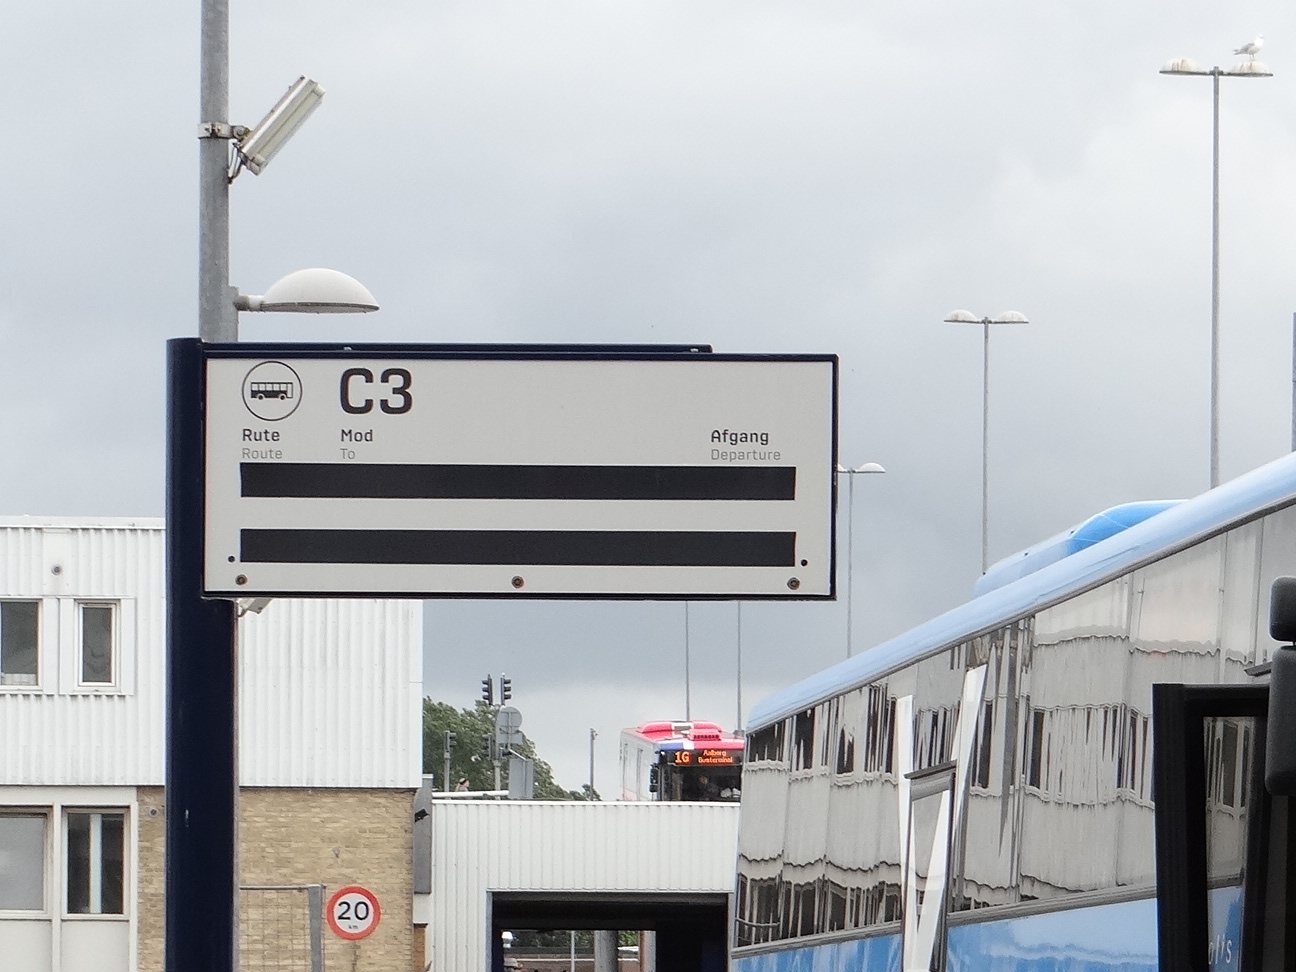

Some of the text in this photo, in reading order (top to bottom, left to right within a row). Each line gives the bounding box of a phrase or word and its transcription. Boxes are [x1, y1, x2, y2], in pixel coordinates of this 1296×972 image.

[339, 367, 413, 415] C3
[241, 428, 280, 443] Rute
[340, 428, 374, 443] Mod
[710, 428, 770, 446] Afgang
[241, 446, 283, 460] Route
[340, 446, 356, 460] To
[710, 448, 781, 463] Departure
[675, 751, 690, 763] 1G
[337, 901, 369, 921] 20
